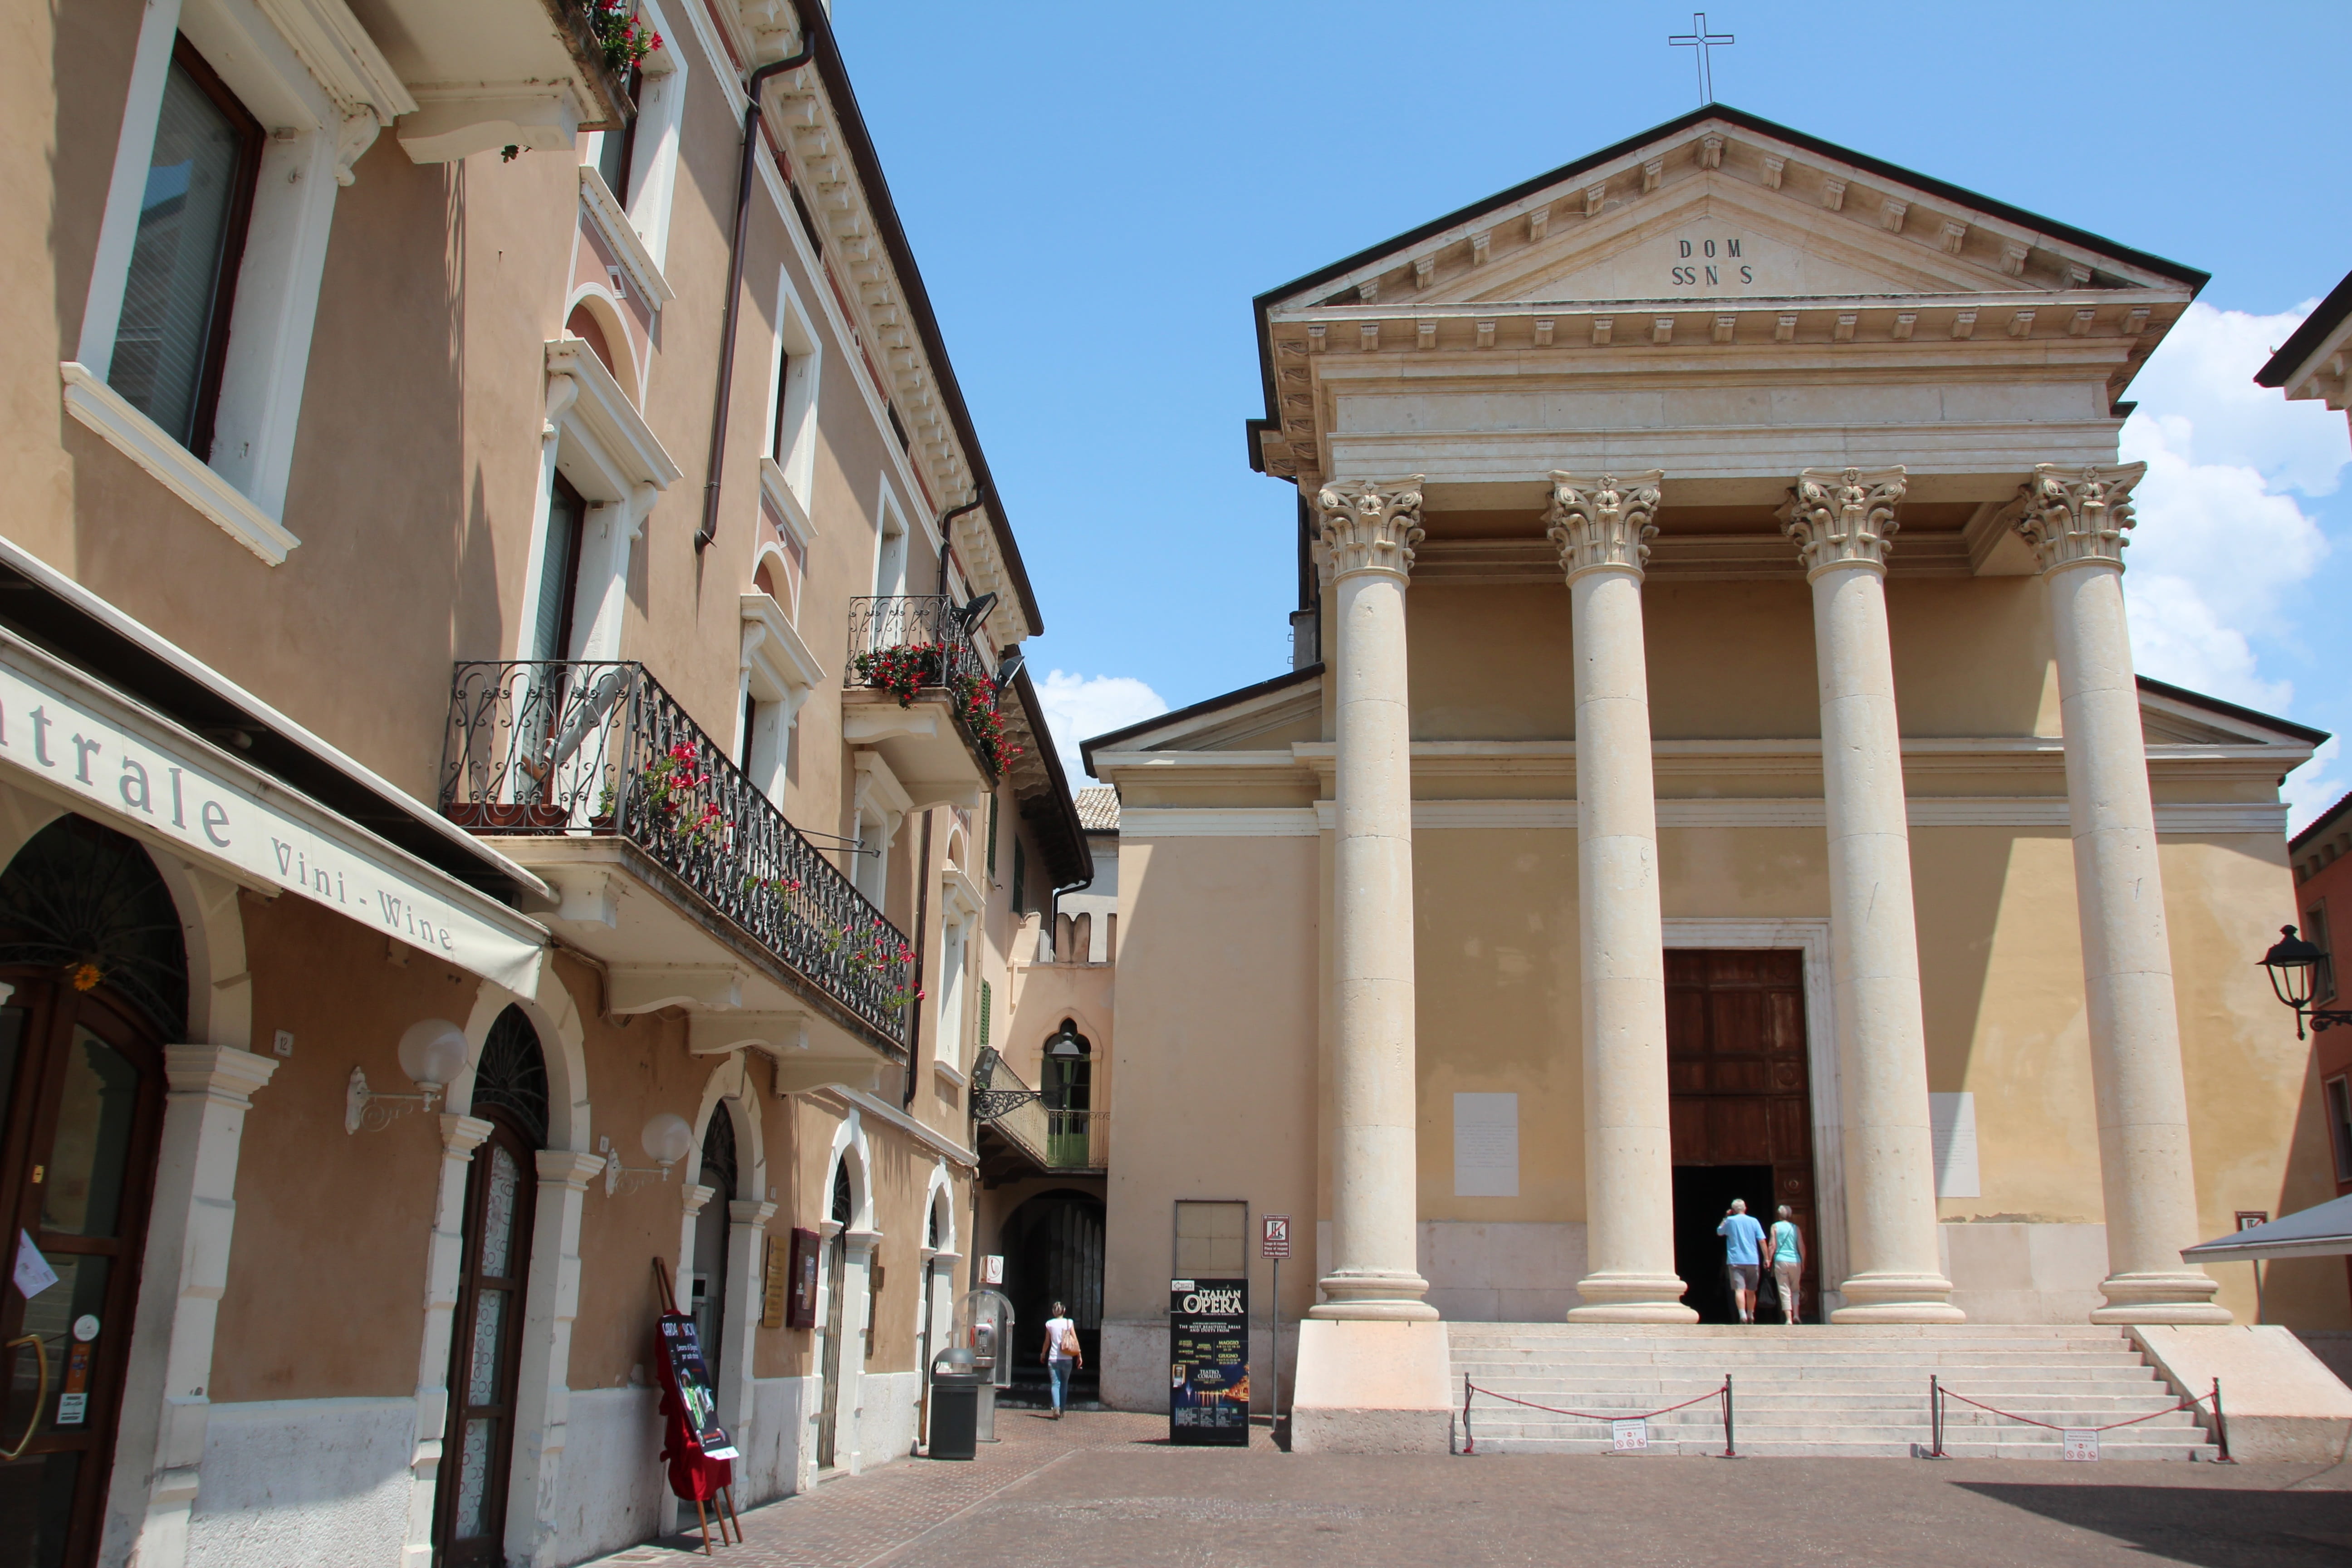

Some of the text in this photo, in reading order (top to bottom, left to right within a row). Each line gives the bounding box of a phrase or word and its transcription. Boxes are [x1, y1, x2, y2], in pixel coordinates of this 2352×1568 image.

[271, 837, 346, 904] Vini
[377, 889, 453, 950] Wine
[280, 1037, 288, 1051] 12
[1199, 1290, 1241, 1298] ITALIAN
[1183, 1294, 1244, 1313] OPERA
